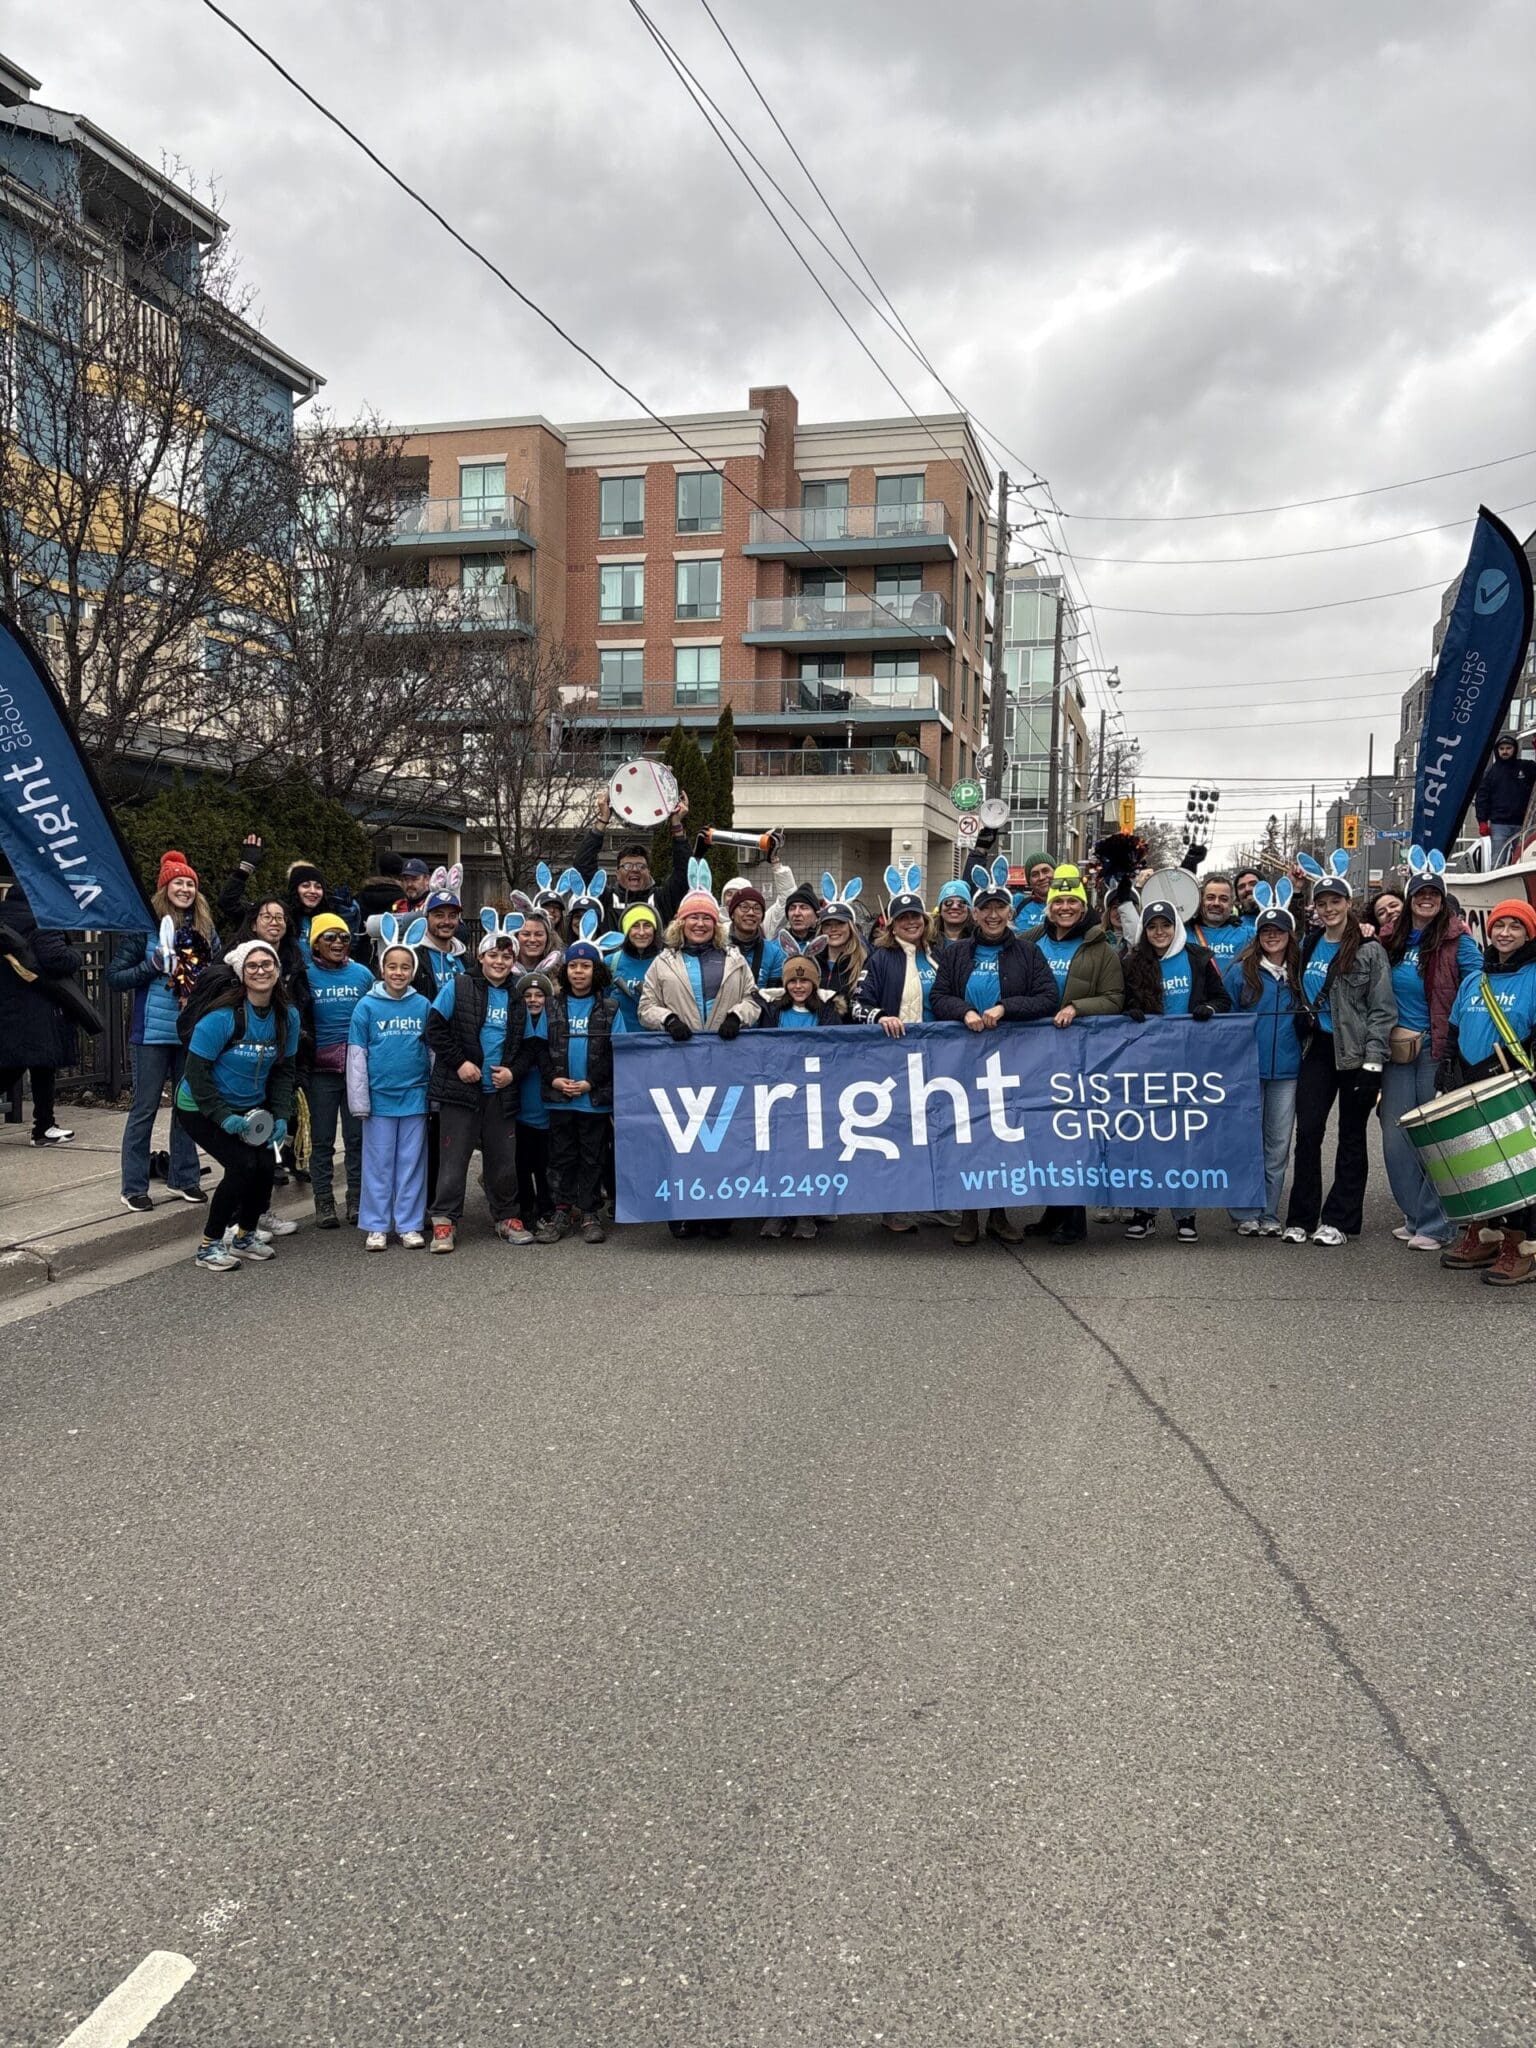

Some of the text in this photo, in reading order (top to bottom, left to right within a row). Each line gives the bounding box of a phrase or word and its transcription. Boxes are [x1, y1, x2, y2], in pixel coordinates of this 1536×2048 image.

[1456, 661, 1488, 724] GROUP
[3, 756, 103, 911] wright
[314, 985, 359, 998] wright
[376, 1015, 422, 1031] wright
[1050, 1071, 1226, 1104] SISTERS
[649, 1051, 1025, 1161] wright
[1052, 1109, 1208, 1142] GROUP
[654, 1173, 849, 1202] 416.694.2499
[959, 1159, 1228, 1196] wrightsisters.com
